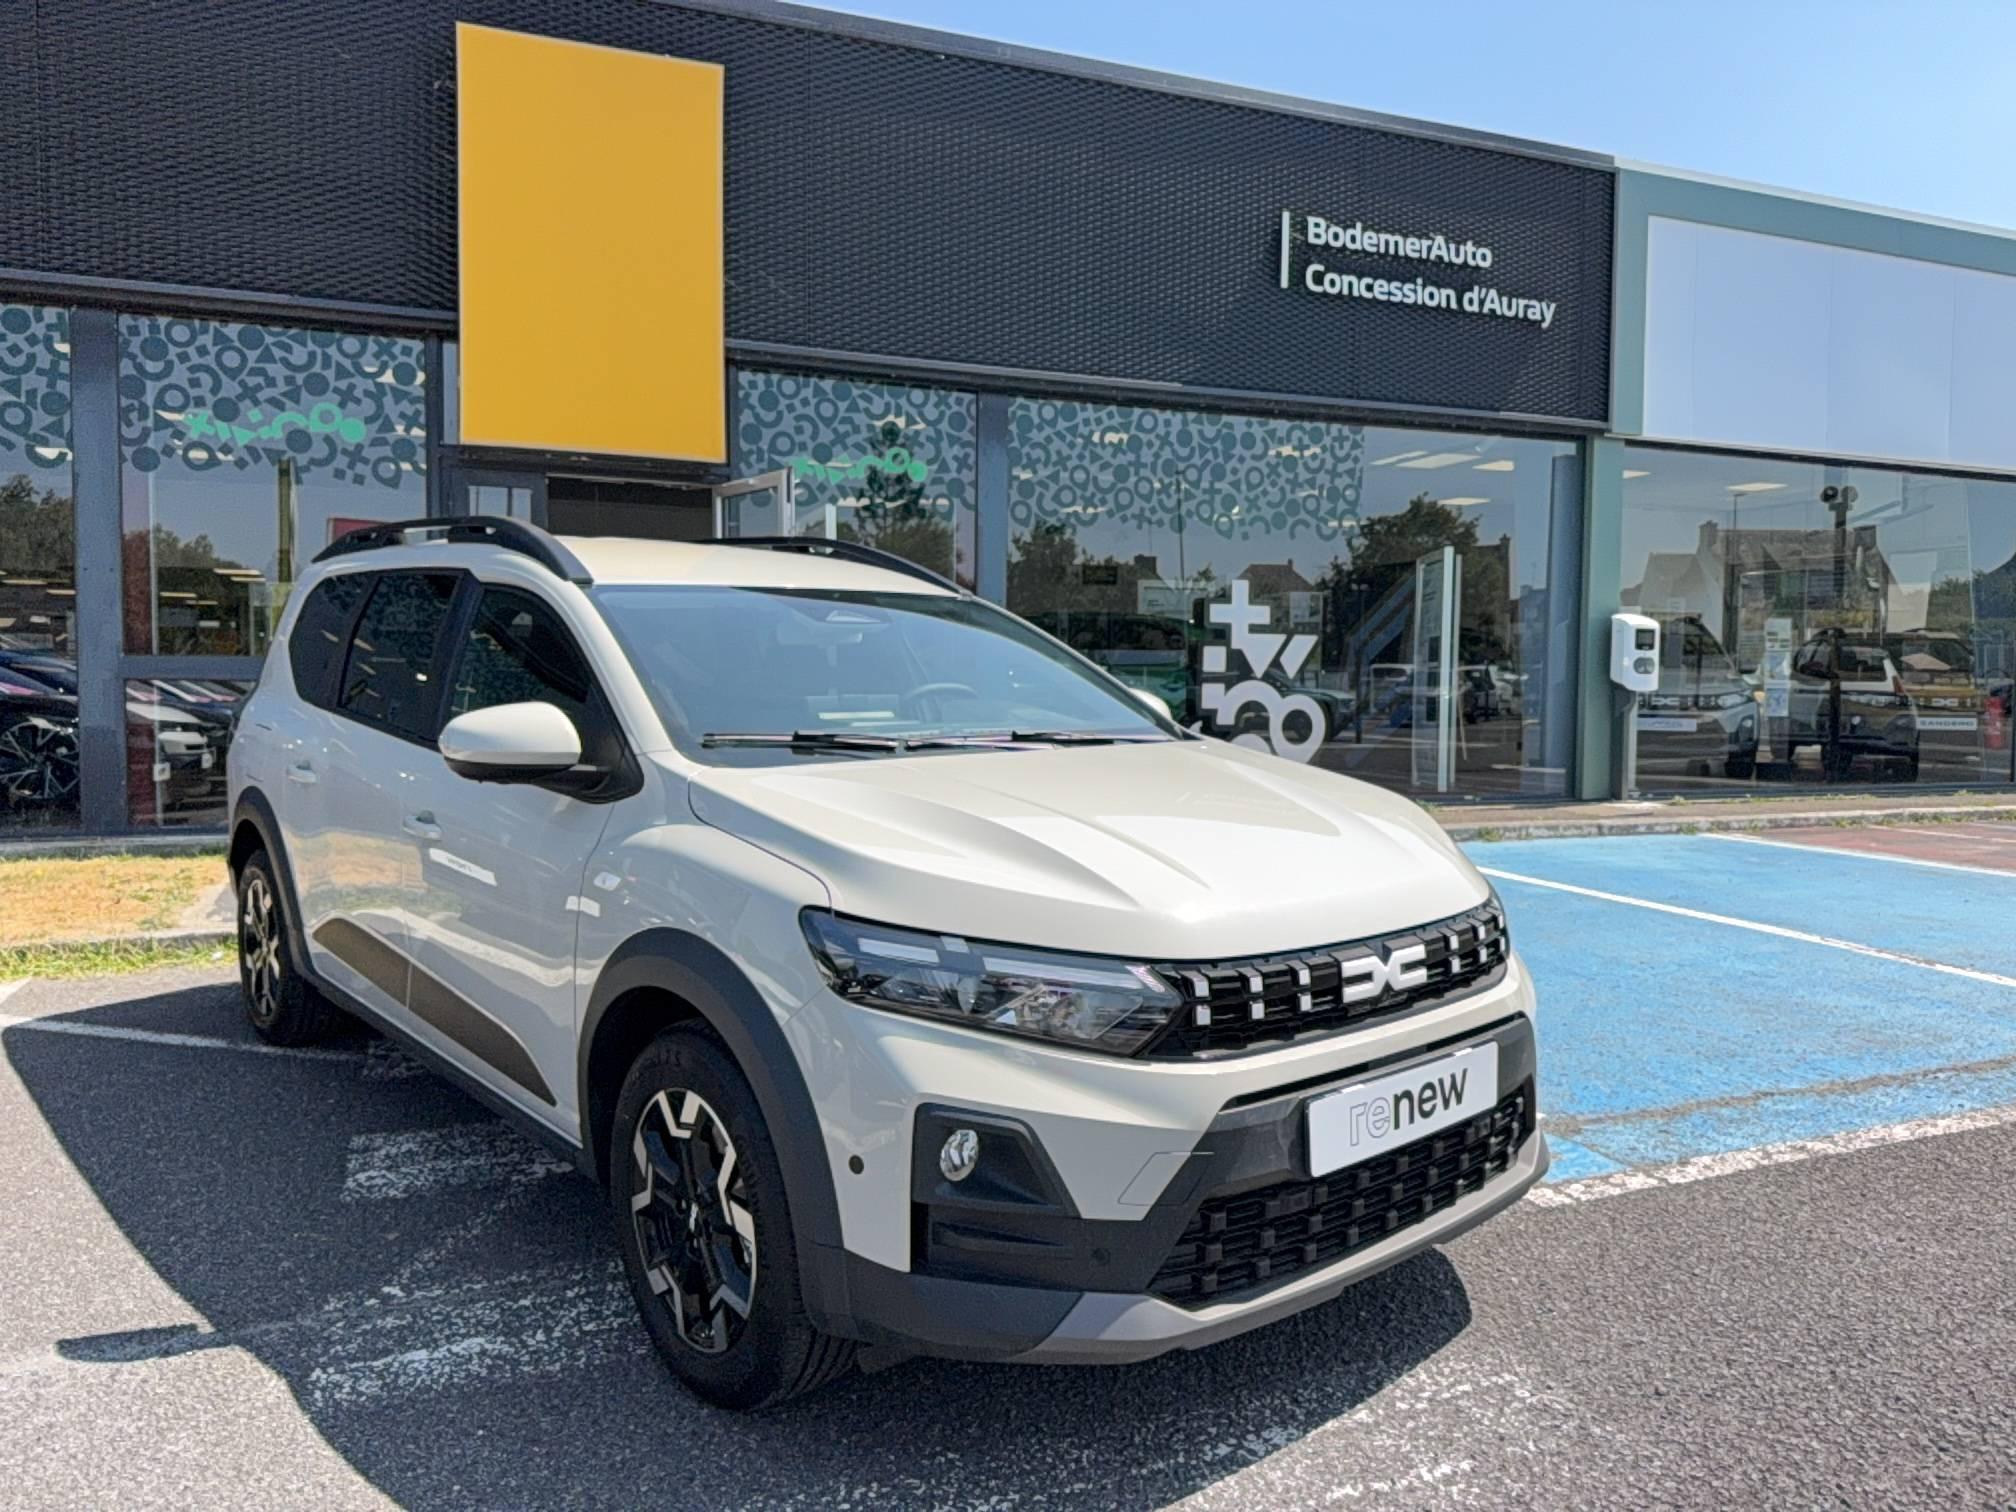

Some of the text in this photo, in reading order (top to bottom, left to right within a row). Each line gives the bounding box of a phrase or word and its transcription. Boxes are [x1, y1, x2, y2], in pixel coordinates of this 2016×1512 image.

[1305, 214, 1493, 268] BodemerAuto
[1304, 263, 1556, 329] Concession d'Auray
[1348, 1066, 1470, 1147] renew
